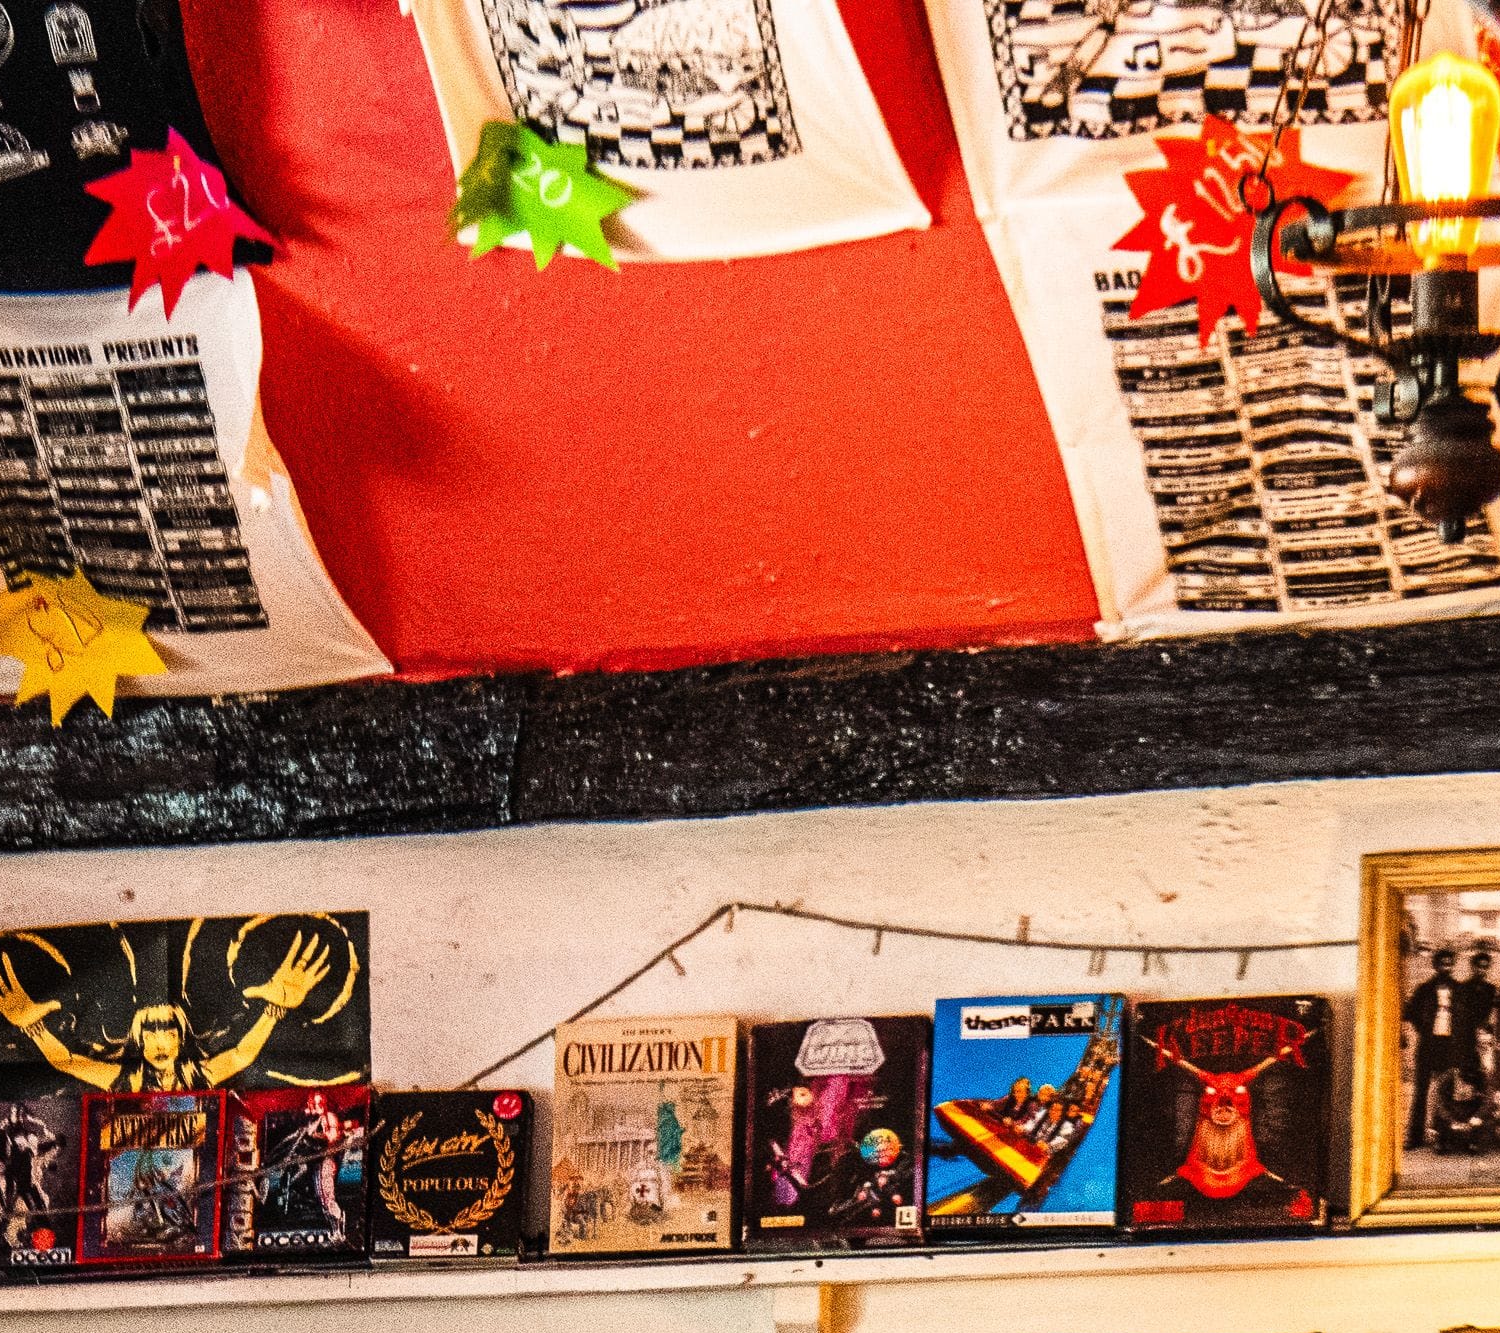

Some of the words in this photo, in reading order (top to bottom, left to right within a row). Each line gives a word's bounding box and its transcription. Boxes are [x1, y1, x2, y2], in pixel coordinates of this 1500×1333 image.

[1094, 270, 1142, 291] BAD
[102, 334, 199, 363] PRESENTS
[563, 1037, 704, 1078] CIVILIZATION
[704, 1036, 728, 1074] II
[403, 1174, 490, 1192] POPULOUS
